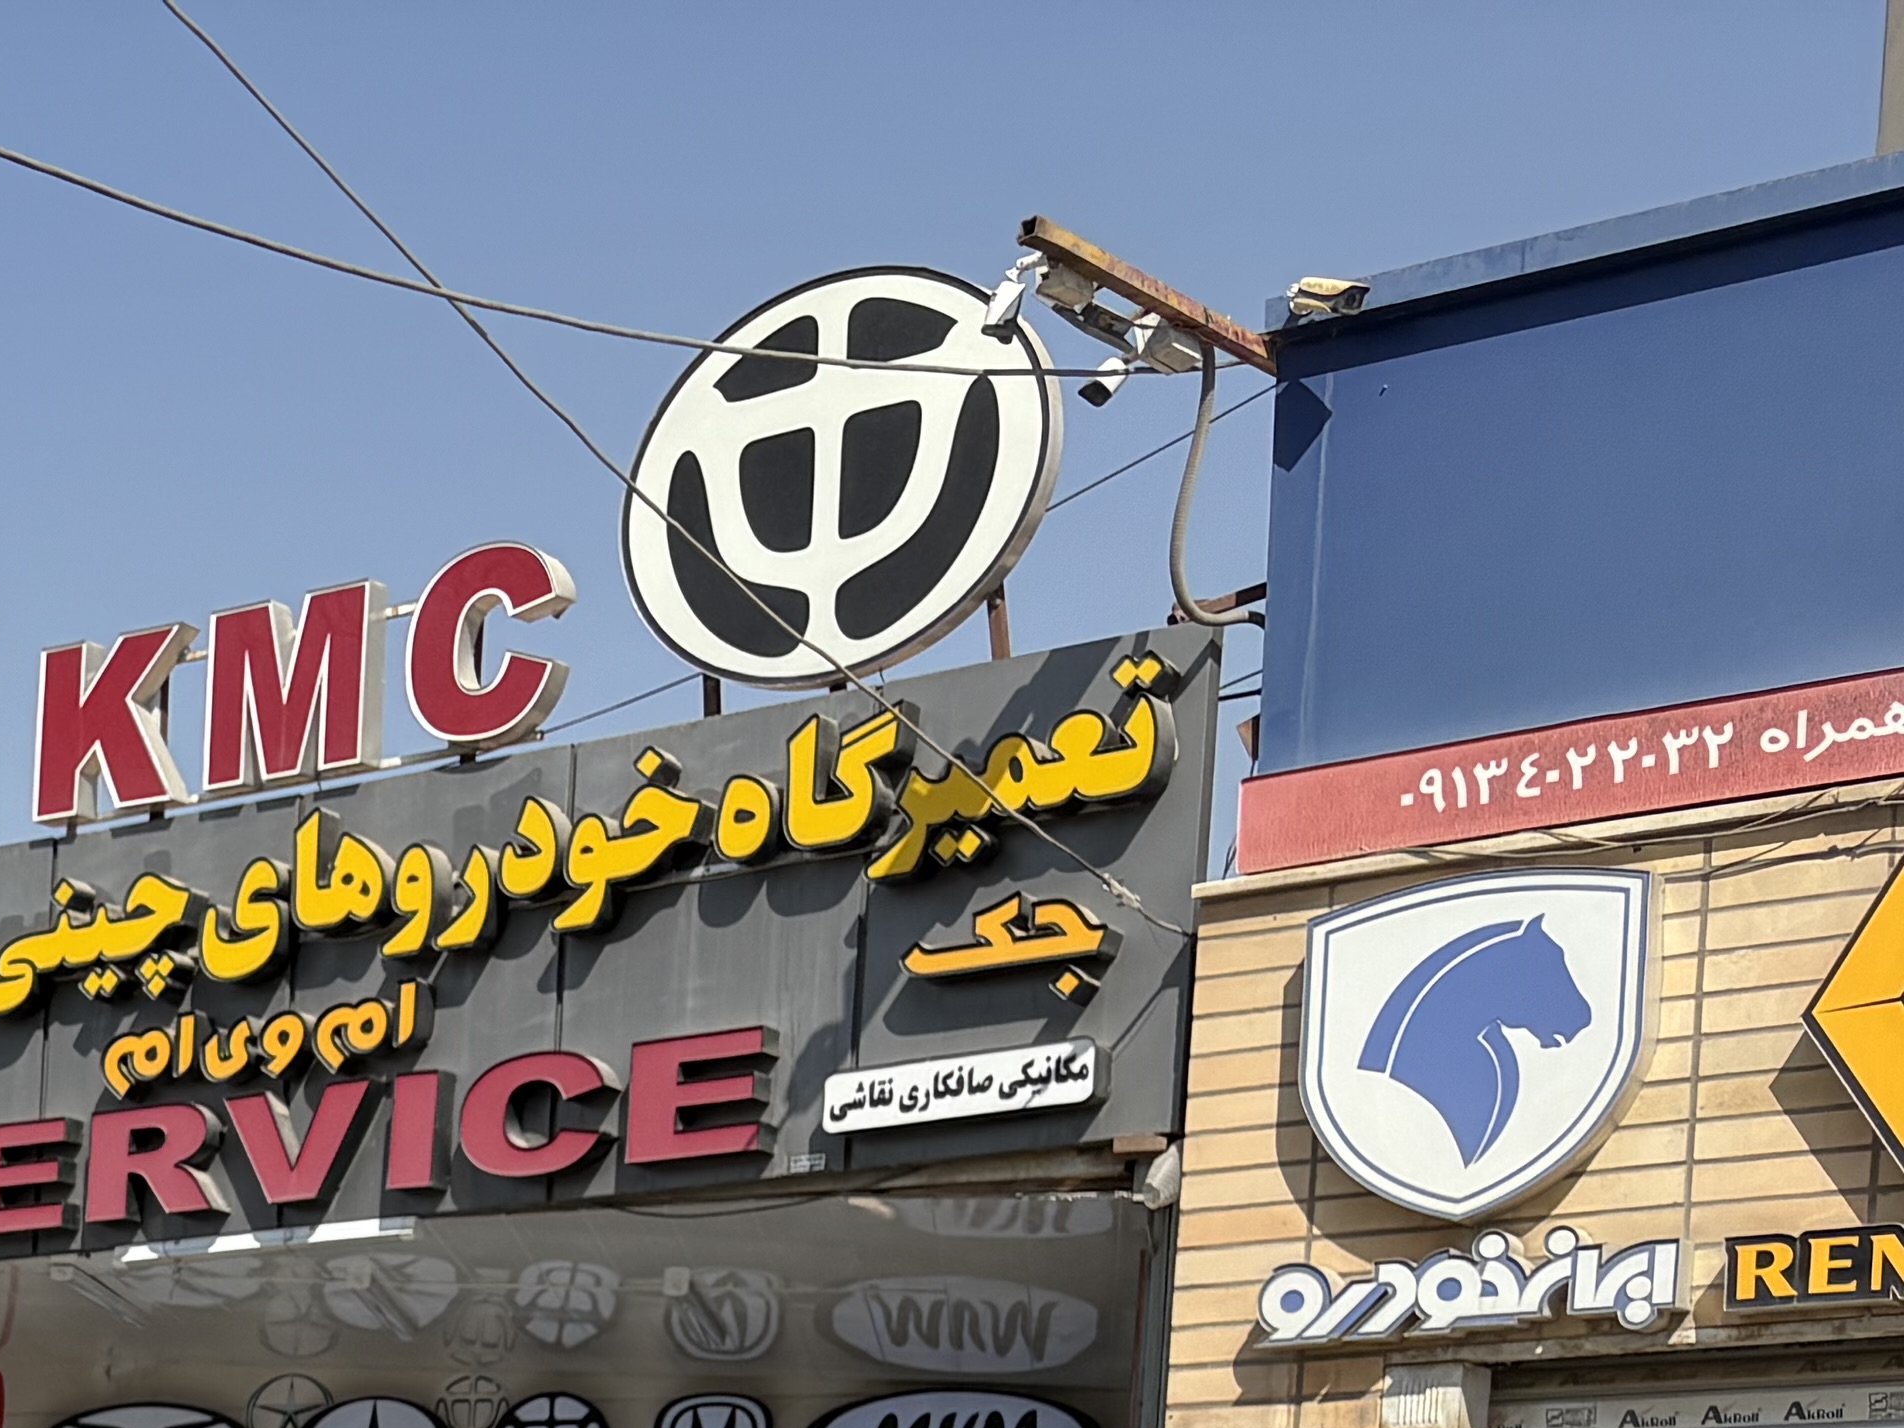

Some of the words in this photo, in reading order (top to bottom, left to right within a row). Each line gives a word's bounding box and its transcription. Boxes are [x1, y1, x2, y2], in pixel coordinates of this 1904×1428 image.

[33, 541, 570, 824] KMC
[715, 653, 1164, 881] تعمیرگاه
[201, 746, 703, 983] خودروهای
[900, 892, 1111, 999] جک
[830, 1078, 894, 1122] نقاشی
[899, 1066, 993, 1113] صافکاری
[998, 1054, 1089, 1099] مکانیکی
